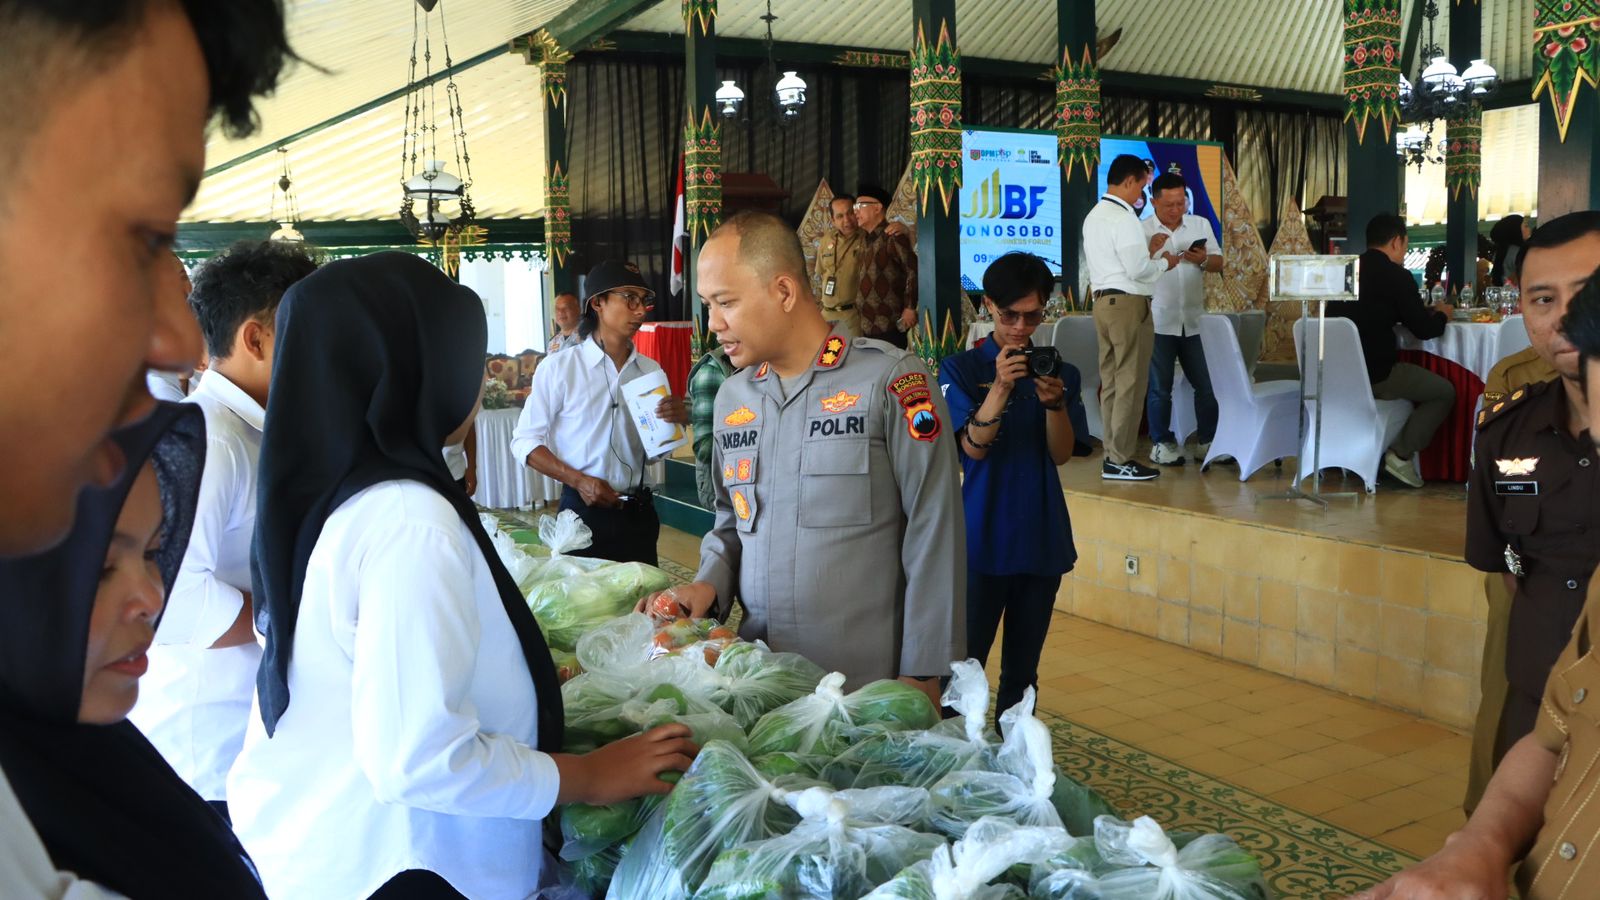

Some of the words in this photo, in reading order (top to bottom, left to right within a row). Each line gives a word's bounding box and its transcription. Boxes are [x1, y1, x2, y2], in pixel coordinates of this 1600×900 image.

[973, 253, 987, 263] 09
[893, 374, 923, 389] POLRES
[809, 416, 864, 437] POLRI
[721, 430, 758, 450] AKBAR
